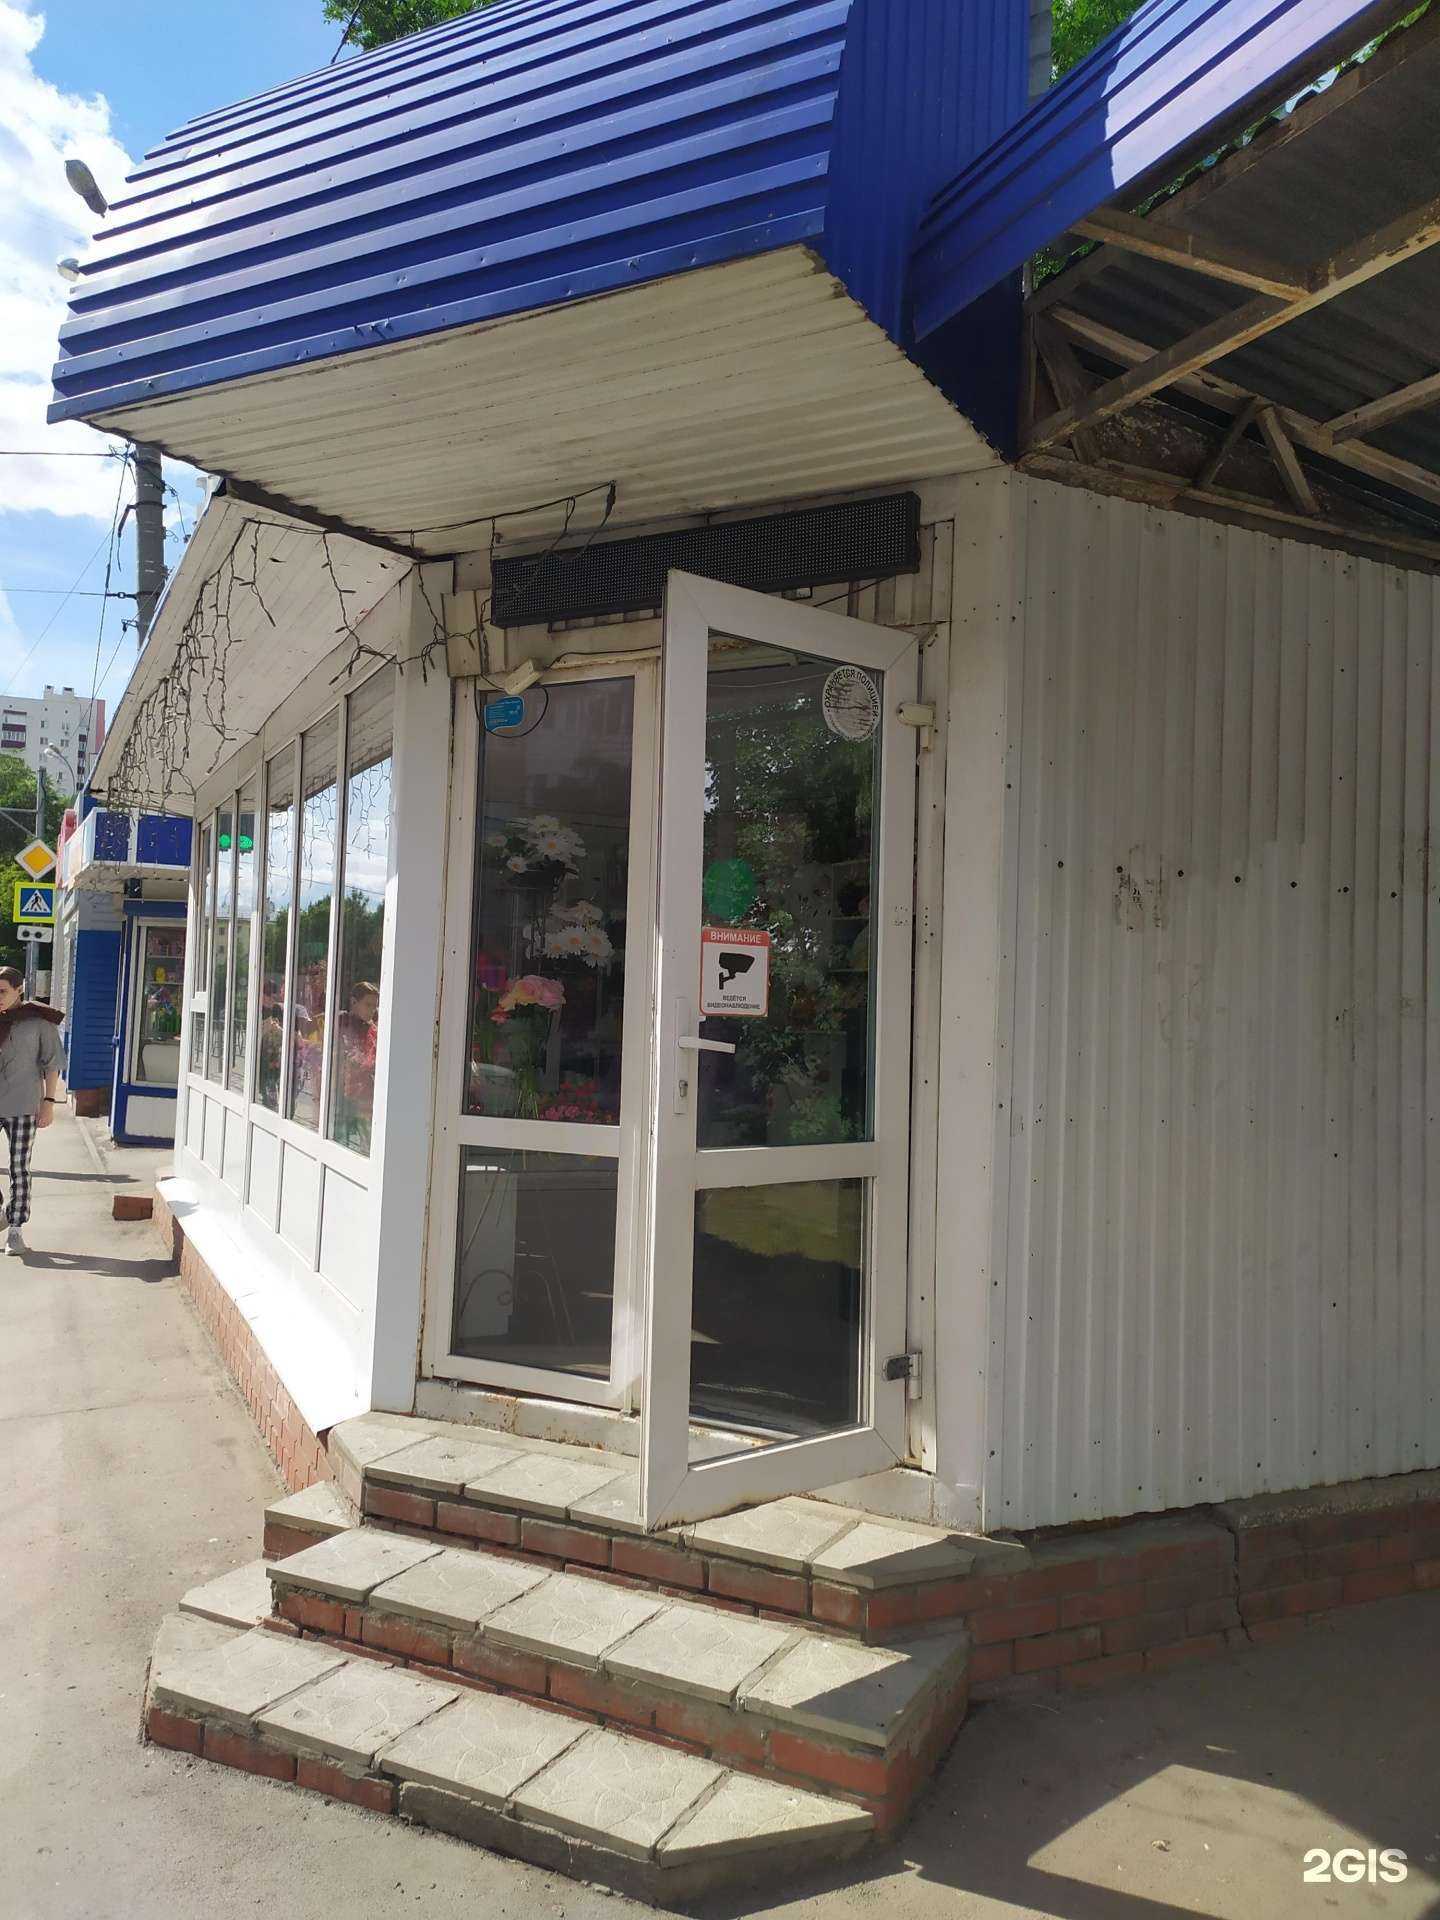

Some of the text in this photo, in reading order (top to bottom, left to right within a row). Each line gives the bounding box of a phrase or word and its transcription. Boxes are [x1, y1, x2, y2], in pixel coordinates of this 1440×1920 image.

[824, 668, 880, 718] ОХРАНЯЕТСЯ ПОЛИЦИЕЙ
[710, 931, 762, 944] ВНИМАНИЕ
